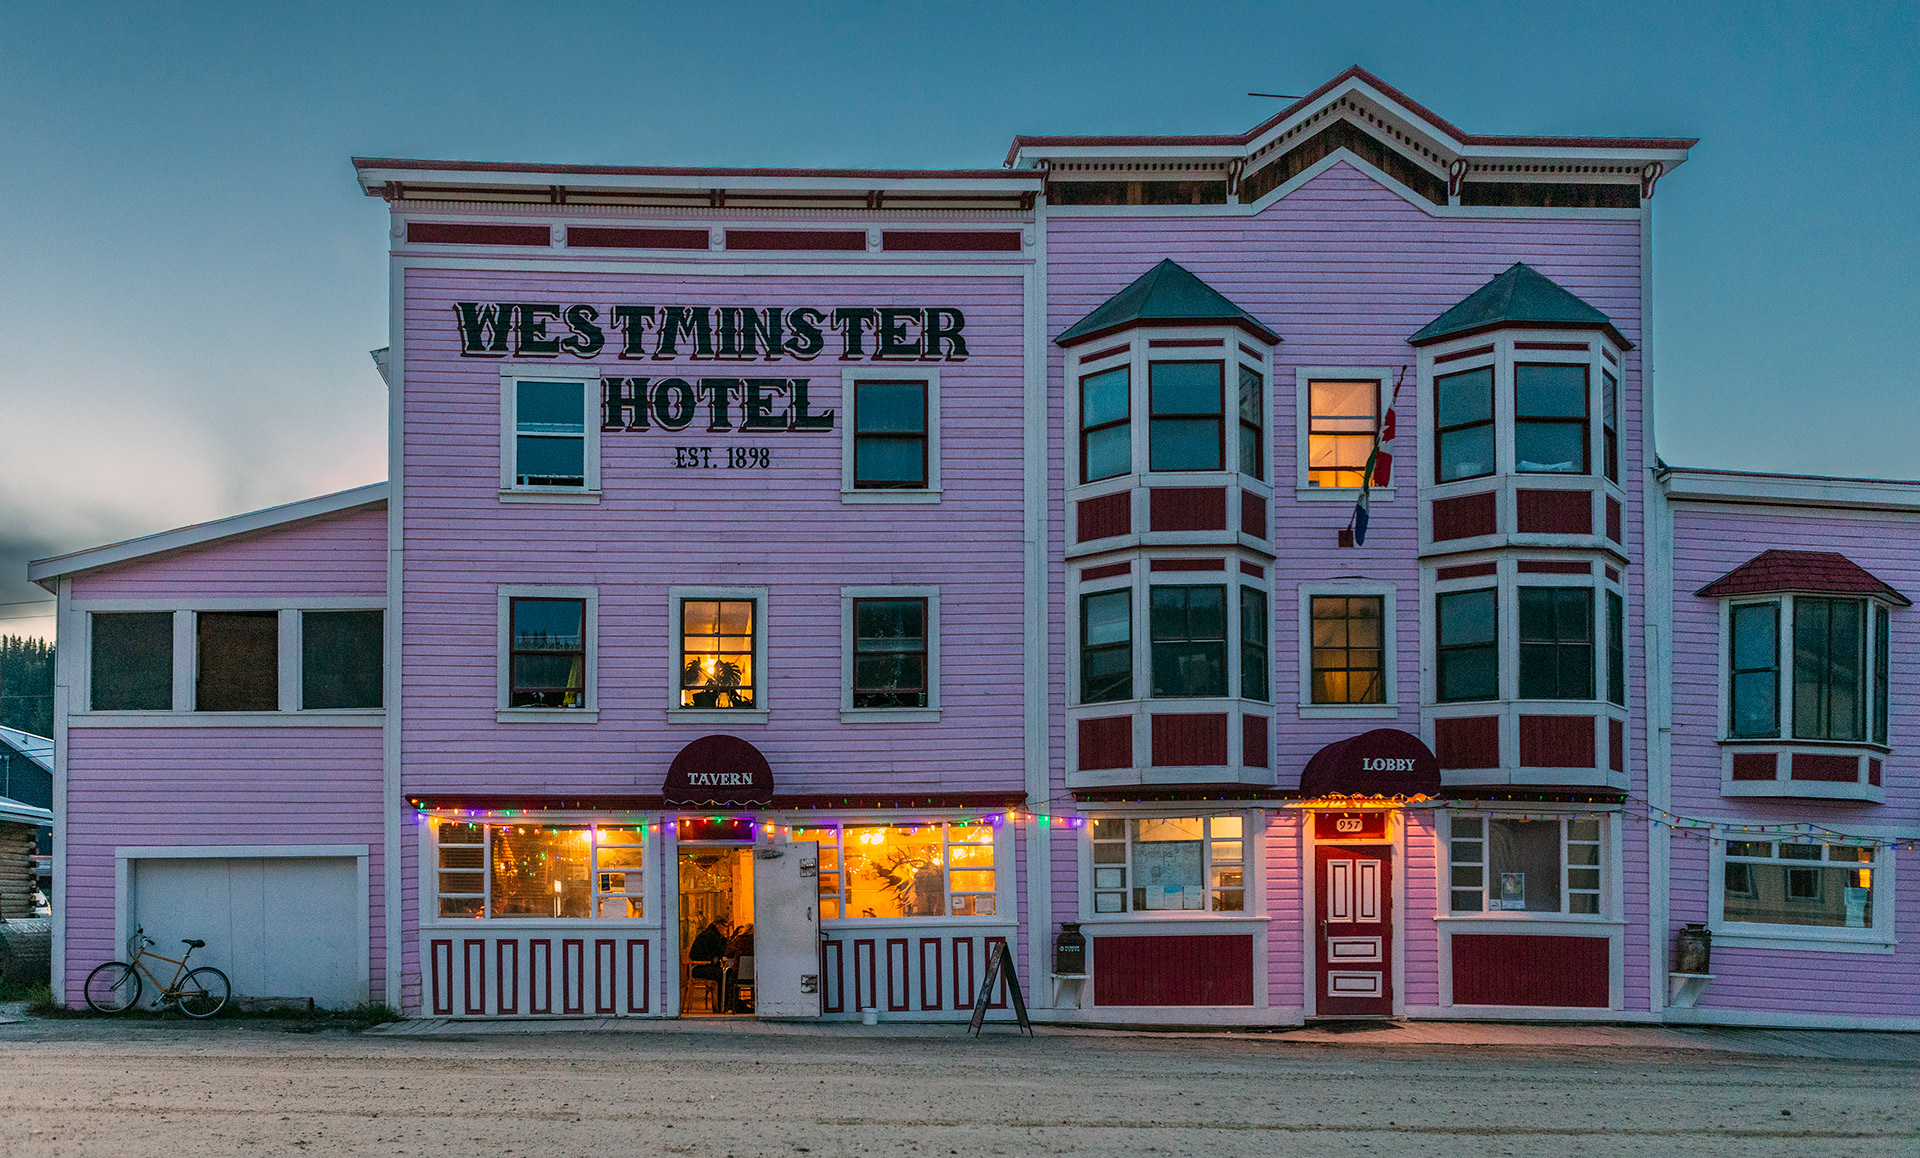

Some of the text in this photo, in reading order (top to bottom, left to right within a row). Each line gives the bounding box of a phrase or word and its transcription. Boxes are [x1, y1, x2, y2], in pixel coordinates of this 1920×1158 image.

[453, 302, 969, 361] WESTMINSTER
[600, 377, 834, 433] HOTEL
[675, 446, 770, 468] EST. 1898
[1362, 757, 1416, 771] LOBBY
[687, 772, 753, 786] TAVERN
[1339, 820, 1361, 830] 957
